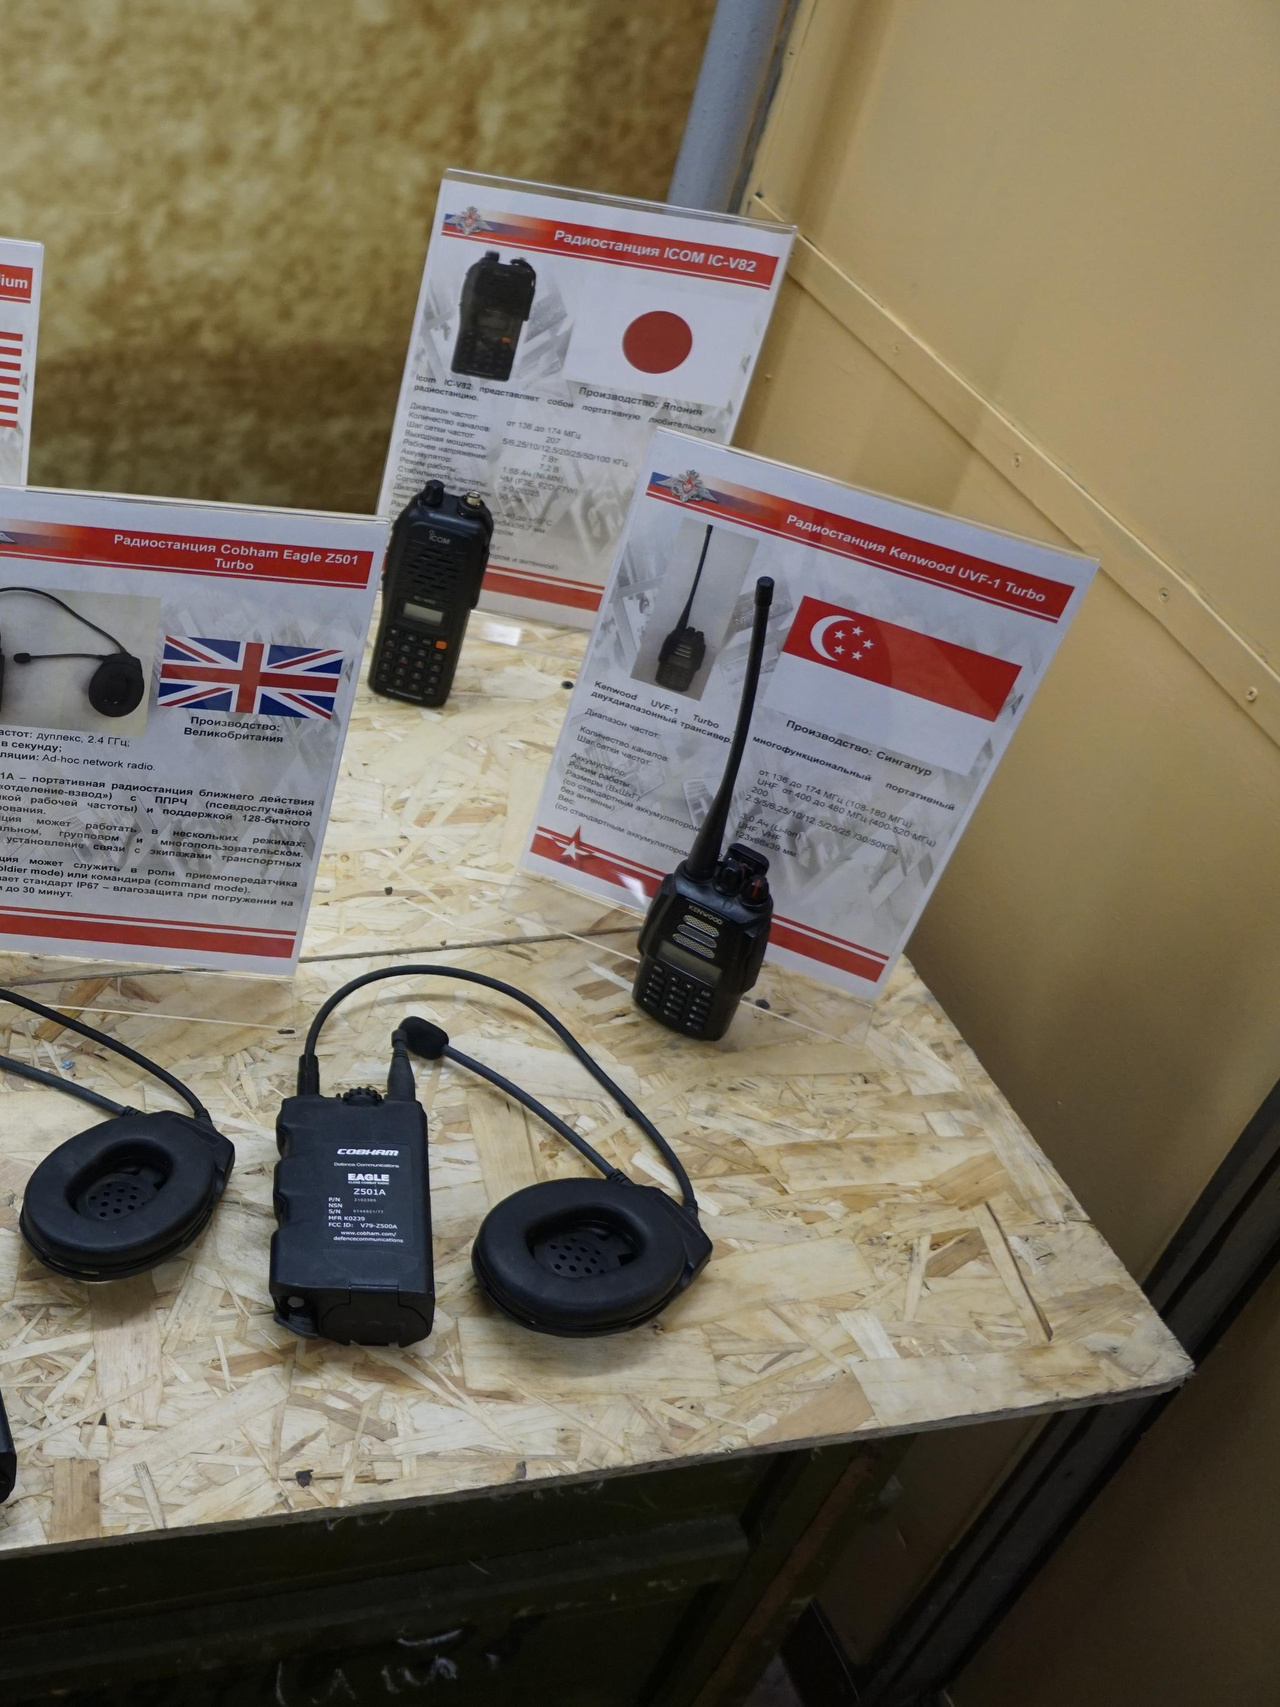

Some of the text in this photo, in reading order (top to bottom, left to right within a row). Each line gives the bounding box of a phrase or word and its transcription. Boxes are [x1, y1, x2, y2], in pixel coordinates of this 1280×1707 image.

[554, 229, 757, 272] Радиостанция ICOM IC-V82
[579, 386, 703, 416] Производство: Япония
[114, 534, 358, 565] Радиостанция Cobham Eagle Z501
[786, 514, 1046, 602] Радиостанция Kenwood UVF-1 Turbo
[214, 557, 254, 571] Turbo
[184, 727, 284, 743] Великобритания
[190, 716, 280, 732] Производство:
[11, 742, 62, 753] секунду;
[36, 732, 83, 743] дуплекс,
[87, 735, 104, 744] 2.4
[107, 737, 130, 747] ГГц;
[786, 719, 932, 776] Производство: Сингапур
[41, 754, 80, 764] Ad-hoc
[83, 759, 123, 768] network
[127, 762, 155, 771] radio.
[32, 776, 106, 788] портативная
[111, 783, 193, 796] радиостанция
[199, 789, 254, 801] ближнего
[259, 795, 315, 806] действия
[30, 797, 78, 807] рабочей
[87, 802, 138, 813] частоты)
[162, 808, 233, 820] поддержкой
[242, 814, 310, 827] 128-битного
[155, 796, 188, 806] ППРЧ
[205, 800, 313, 817] (псевдослучайной
[36, 819, 72, 827] может
[85, 821, 137, 834] работать
[172, 830, 238, 842] нескольких
[252, 837, 306, 848] режимах:
[58, 831, 119, 843] групповом
[160, 840, 303, 858] многопользовательском.
[6, 836, 85, 850] установление
[93, 844, 125, 852] связи
[149, 848, 212, 860] экипажами
[221, 855, 302, 868] транспортных
[29, 859, 63, 867] может
[73, 862, 123, 872] служить
[185, 872, 298, 887] приемопередатчика
[30, 869, 64, 878] mode)
[91, 874, 151, 885] командира
[154, 878, 211, 890] (command
[214, 885, 250, 894] mode).
[23, 878, 73, 888] стандарт
[76, 881, 99, 889] IP67
[113, 886, 183, 897] влагозащита
[187, 892, 208, 900] при
[211, 894, 277, 905] погружении
[38, 889, 73, 898] минут.
[688, 904, 723, 925] KENWOOD
[337, 1148, 399, 1156] COBHAM
[347, 1173, 390, 1182] EAGLE
[353, 1188, 386, 1196] Z501A
